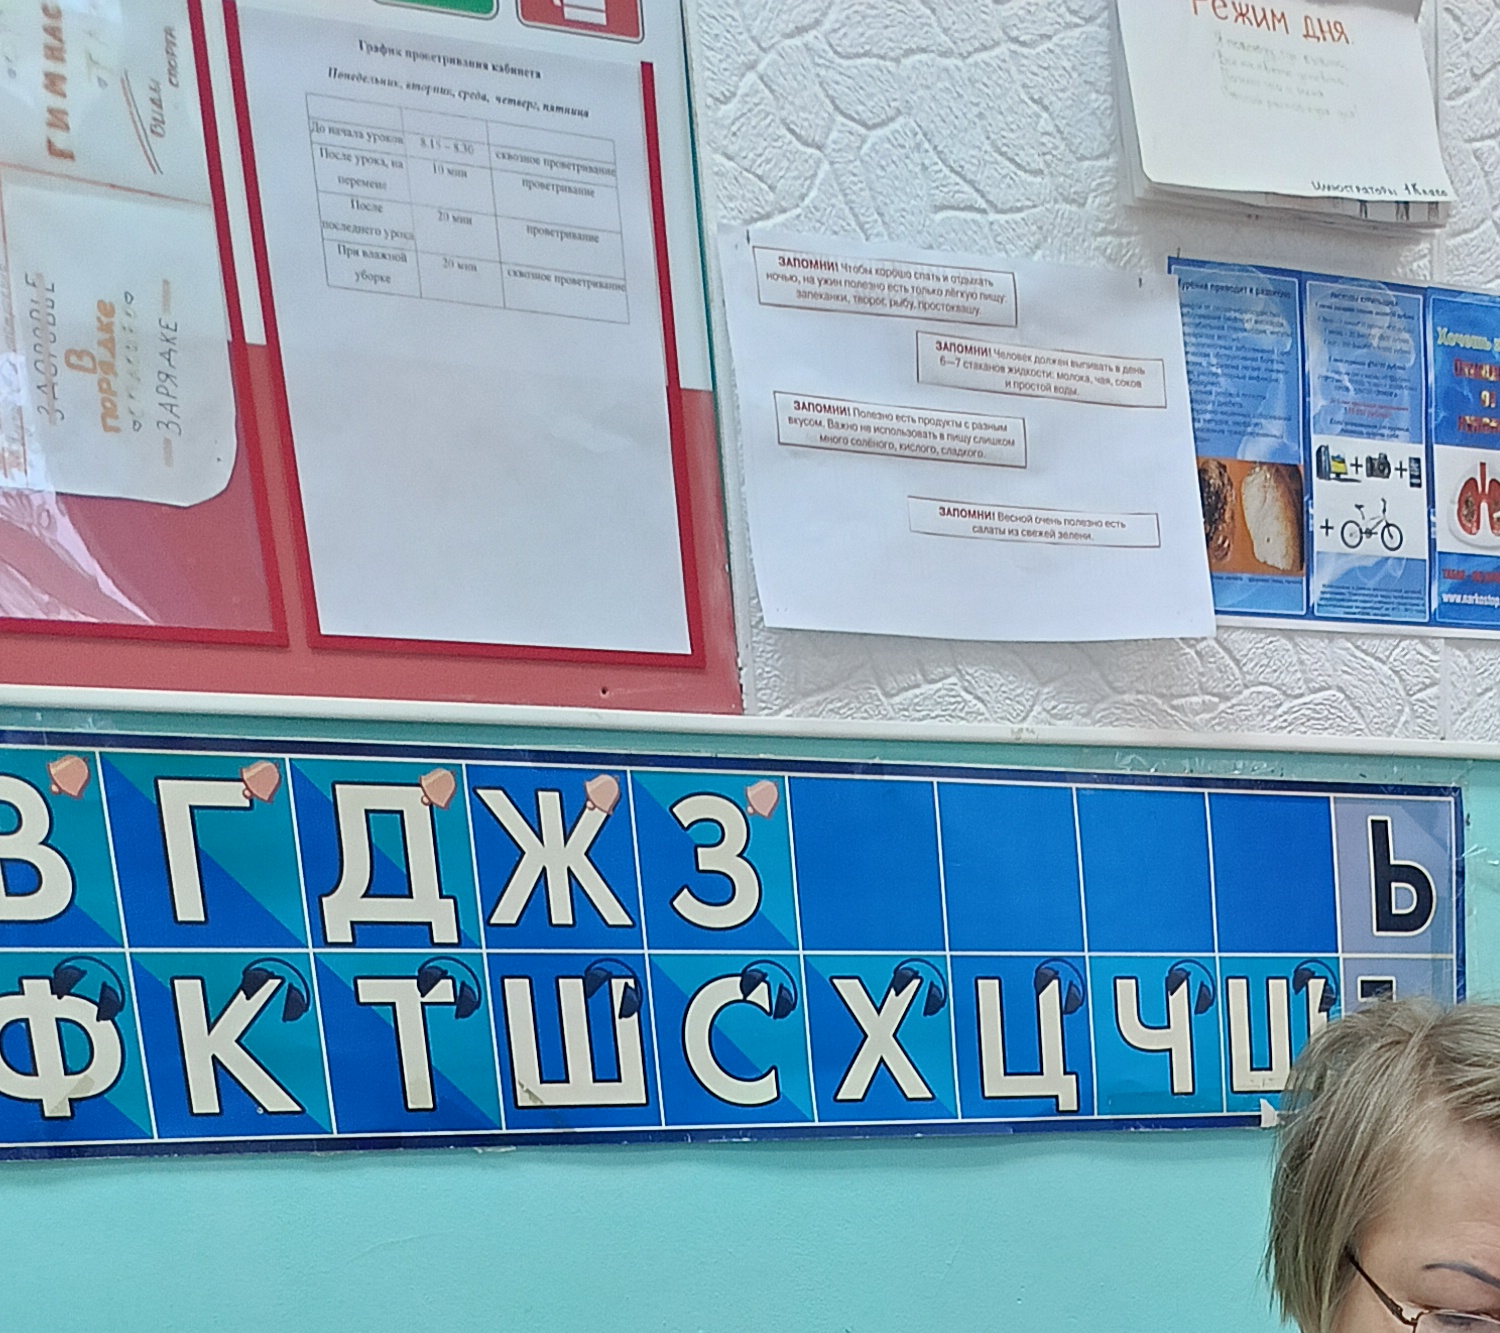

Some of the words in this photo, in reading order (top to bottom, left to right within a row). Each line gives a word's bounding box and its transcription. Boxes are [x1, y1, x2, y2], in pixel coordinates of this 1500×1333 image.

[358, 39, 402, 57] График
[405, 50, 489, 71] проветривания
[491, 64, 541, 79] кабинета
[543, 103, 589, 118] пятница
[310, 121, 326, 134] До
[328, 126, 364, 140] начала
[366, 129, 403, 145] уроков
[320, 147, 351, 162] После
[495, 151, 540, 165] сквозное
[543, 158, 616, 177] проветривание
[337, 175, 387, 190] перемене
[446, 167, 468, 178] мин
[522, 177, 595, 198] проветривание
[350, 198, 383, 213] После
[322, 220, 381, 237] последнего
[452, 215, 473, 226] мин
[526, 224, 599, 244] проветривание
[337, 243, 360, 258] При
[362, 247, 407, 263] влажной
[354, 269, 391, 285] уборке
[457, 262, 478, 272] мин
[777, 255, 838, 273] ЗАПОМНИ!
[839, 261, 872, 275] Чтобы
[873, 266, 911, 281] хорошо
[913, 270, 941, 283] спать
[507, 268, 551, 282] сквозное
[554, 273, 626, 292] проветривание
[766, 270, 801, 285] ночью,
[803, 274, 816, 285] на
[816, 276, 843, 291] ужин
[844, 278, 884, 292] полезно
[887, 282, 909, 293] есть
[910, 284, 943, 297] только
[796, 287, 851, 305] запеканки,
[853, 292, 887, 308] творог,
[889, 295, 918, 311] рыбу,
[64, 348, 98, 374] В
[935, 340, 992, 358] ЗАПОМНИ!
[993, 348, 1033, 363] Человек
[1033, 353, 1069, 368] должен
[1070, 358, 1113, 372] выпивать
[1121, 363, 1146, 376] день
[156, 318, 182, 436] ЗАРЯДКЕ
[962, 359, 1006, 373] стаканов
[1056, 370, 1094, 384] молока,
[1114, 377, 1142, 388] соков
[1013, 378, 1052, 394] простой
[1053, 384, 1080, 396] воды.
[793, 400, 850, 415] ЗАПОМНИ!
[853, 407, 893, 420] Полезно
[894, 413, 916, 422] есть
[917, 415, 962, 429] продукты
[970, 420, 1008, 432] разным
[787, 416, 825, 429] вкусом.
[826, 419, 858, 432] Важно
[873, 425, 938, 440] использовать
[946, 432, 971, 445] пищу
[973, 434, 1015, 447] слишком
[819, 434, 849, 445] много
[850, 436, 898, 451] солёного,
[899, 442, 939, 455] кислого,
[940, 446, 987, 460] сладкого.
[938, 506, 995, 520] ЗАПОМНИ!
[997, 511, 1034, 523] Весной
[1035, 515, 1062, 525] очень
[1063, 517, 1102, 528] полезно
[1104, 519, 1126, 529] есть
[972, 524, 1006, 535] салаты
[1008, 527, 1019, 536] из
[1021, 526, 1056, 538] свежей
[1057, 530, 1093, 541] зелени.
[0, 773, 74, 923] В
[153, 776, 255, 925] Г
[319, 781, 462, 946] Д
[474, 787, 637, 928] Ж
[670, 793, 763, 931] З
[1365, 814, 1437, 936] Ь
[0, 975, 125, 1120] Ф
[170, 975, 306, 1115] К
[354, 975, 458, 1112] Т
[502, 975, 648, 1108] Ш
[682, 974, 780, 1109] С
[829, 975, 936, 1102] Х
[973, 975, 1080, 1113] Ц
[1113, 975, 1198, 1096] Ч
